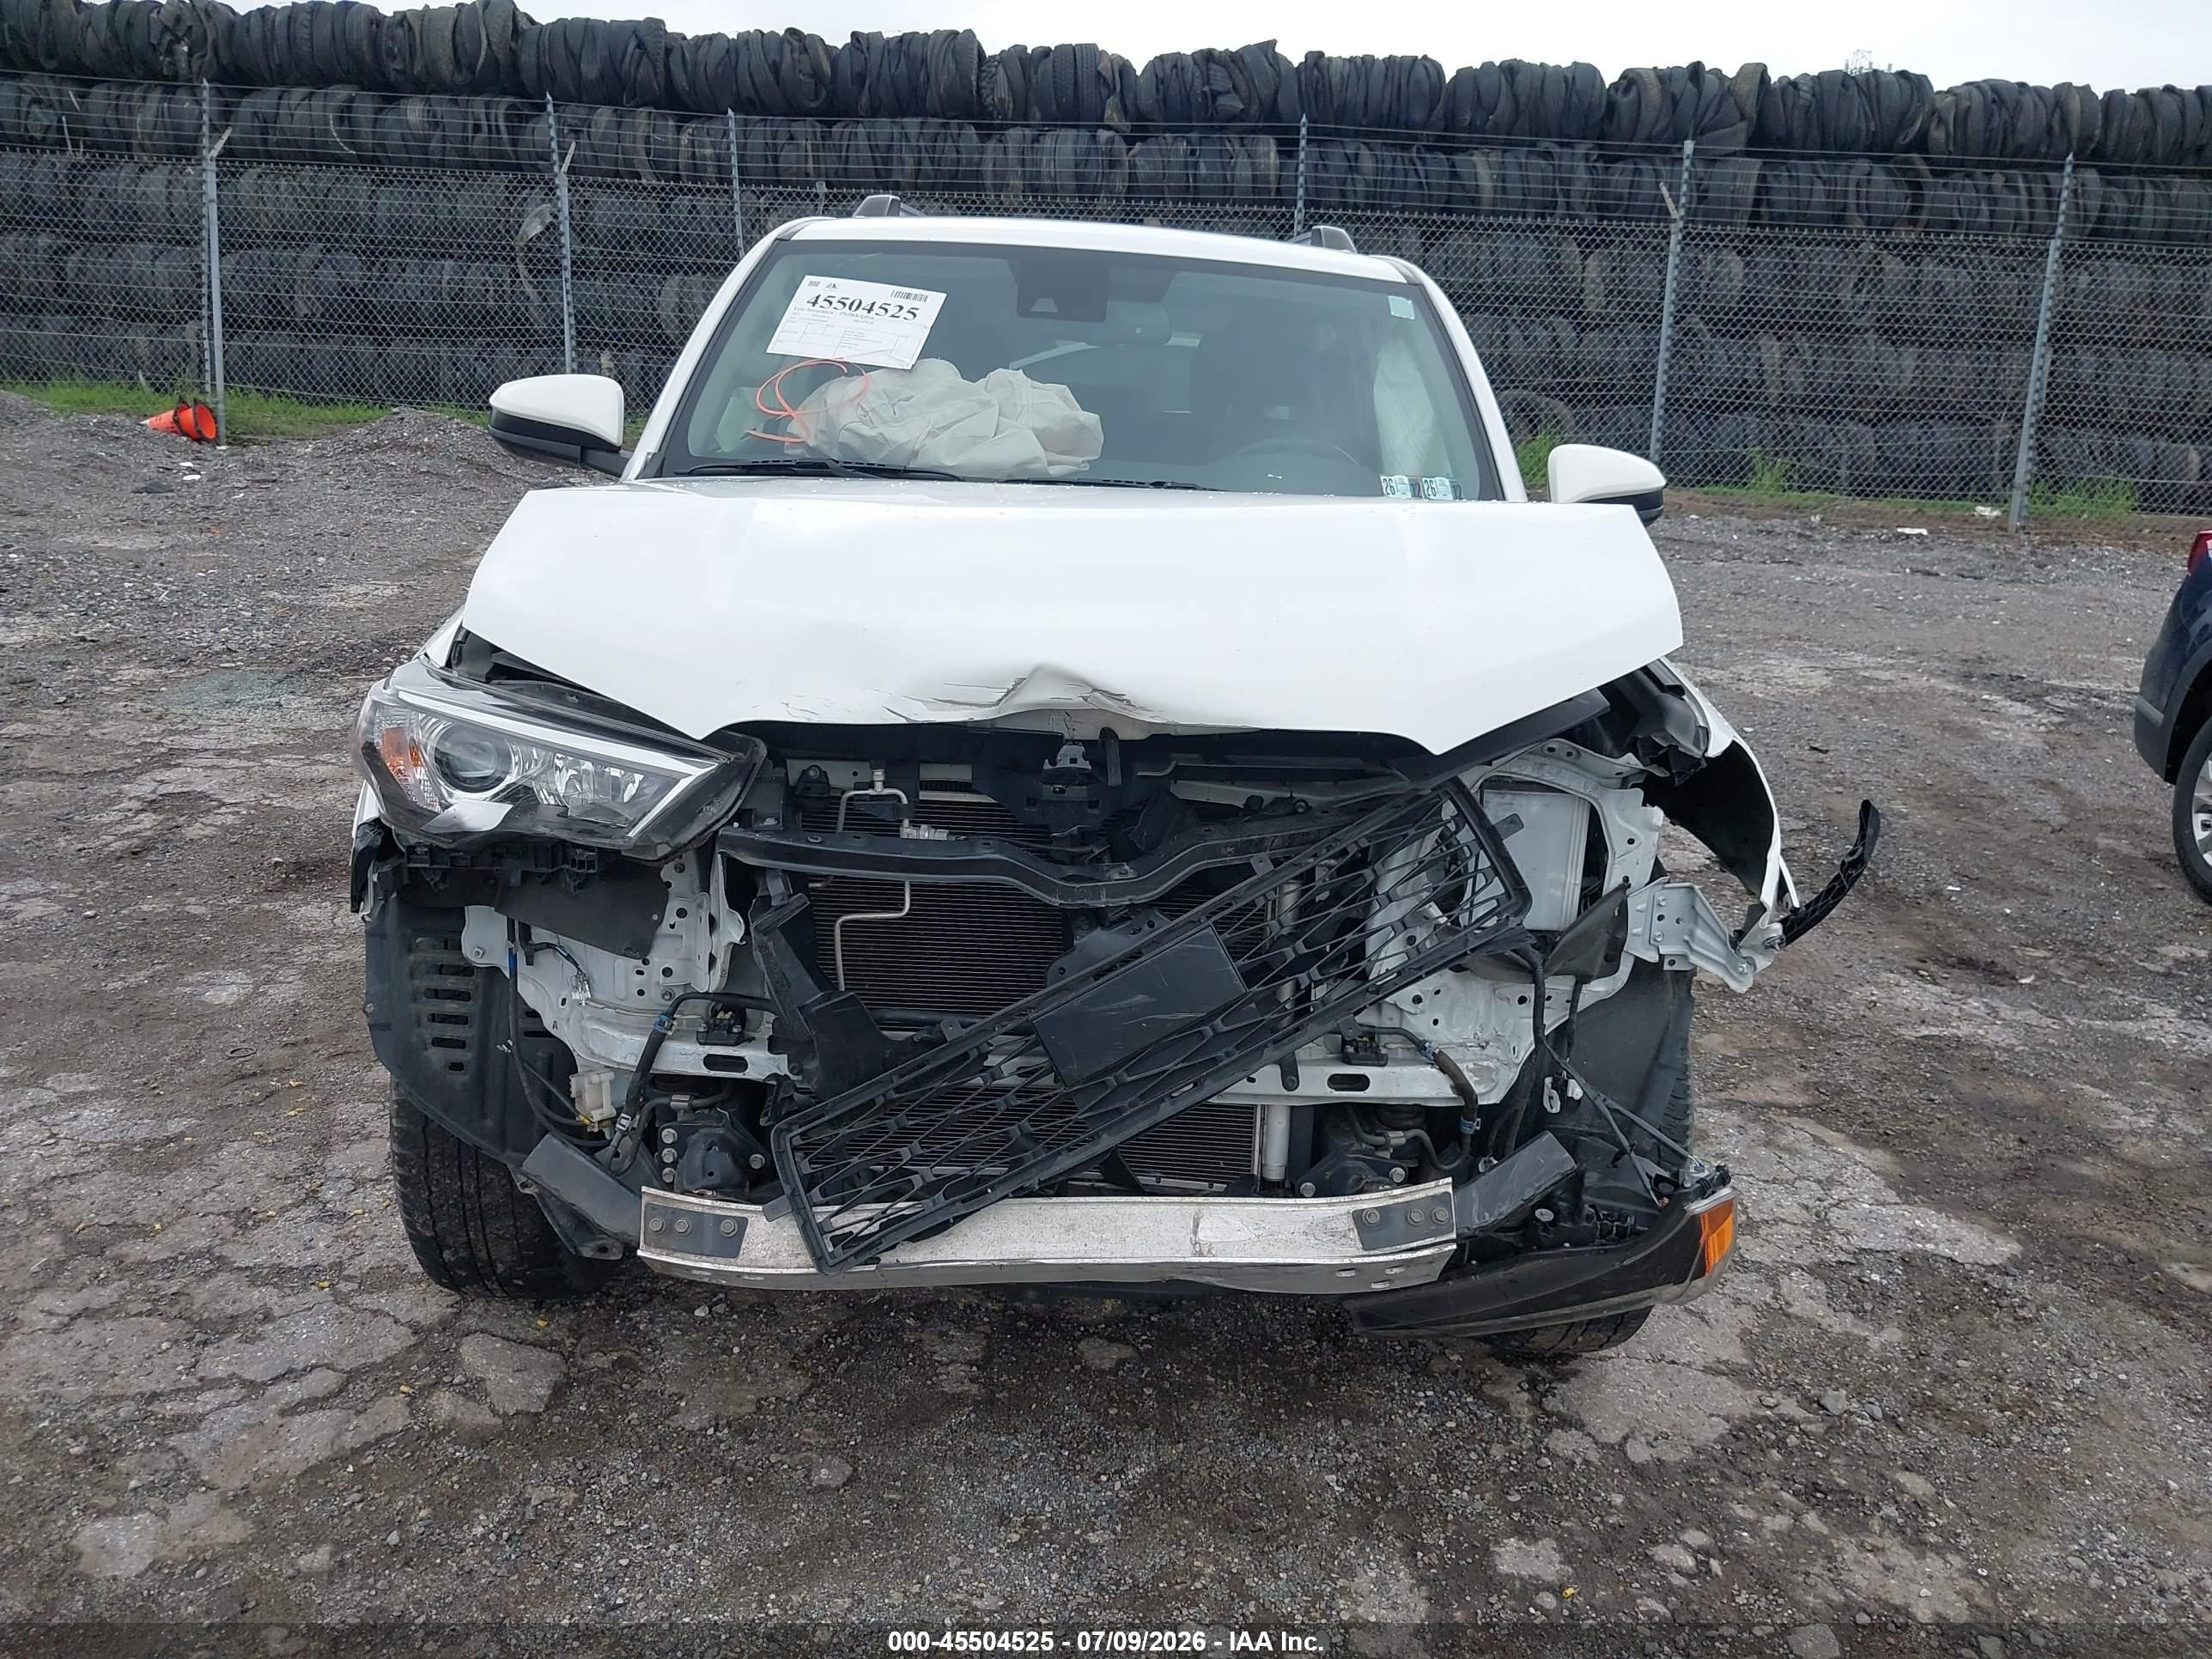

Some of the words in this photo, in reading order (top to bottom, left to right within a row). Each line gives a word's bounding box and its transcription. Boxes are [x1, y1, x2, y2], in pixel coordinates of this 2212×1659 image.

[806, 294, 920, 321] 45504525
[1382, 477, 1395, 495] 26
[1410, 482, 1423, 498] 12
[1425, 479, 1437, 497] 26
